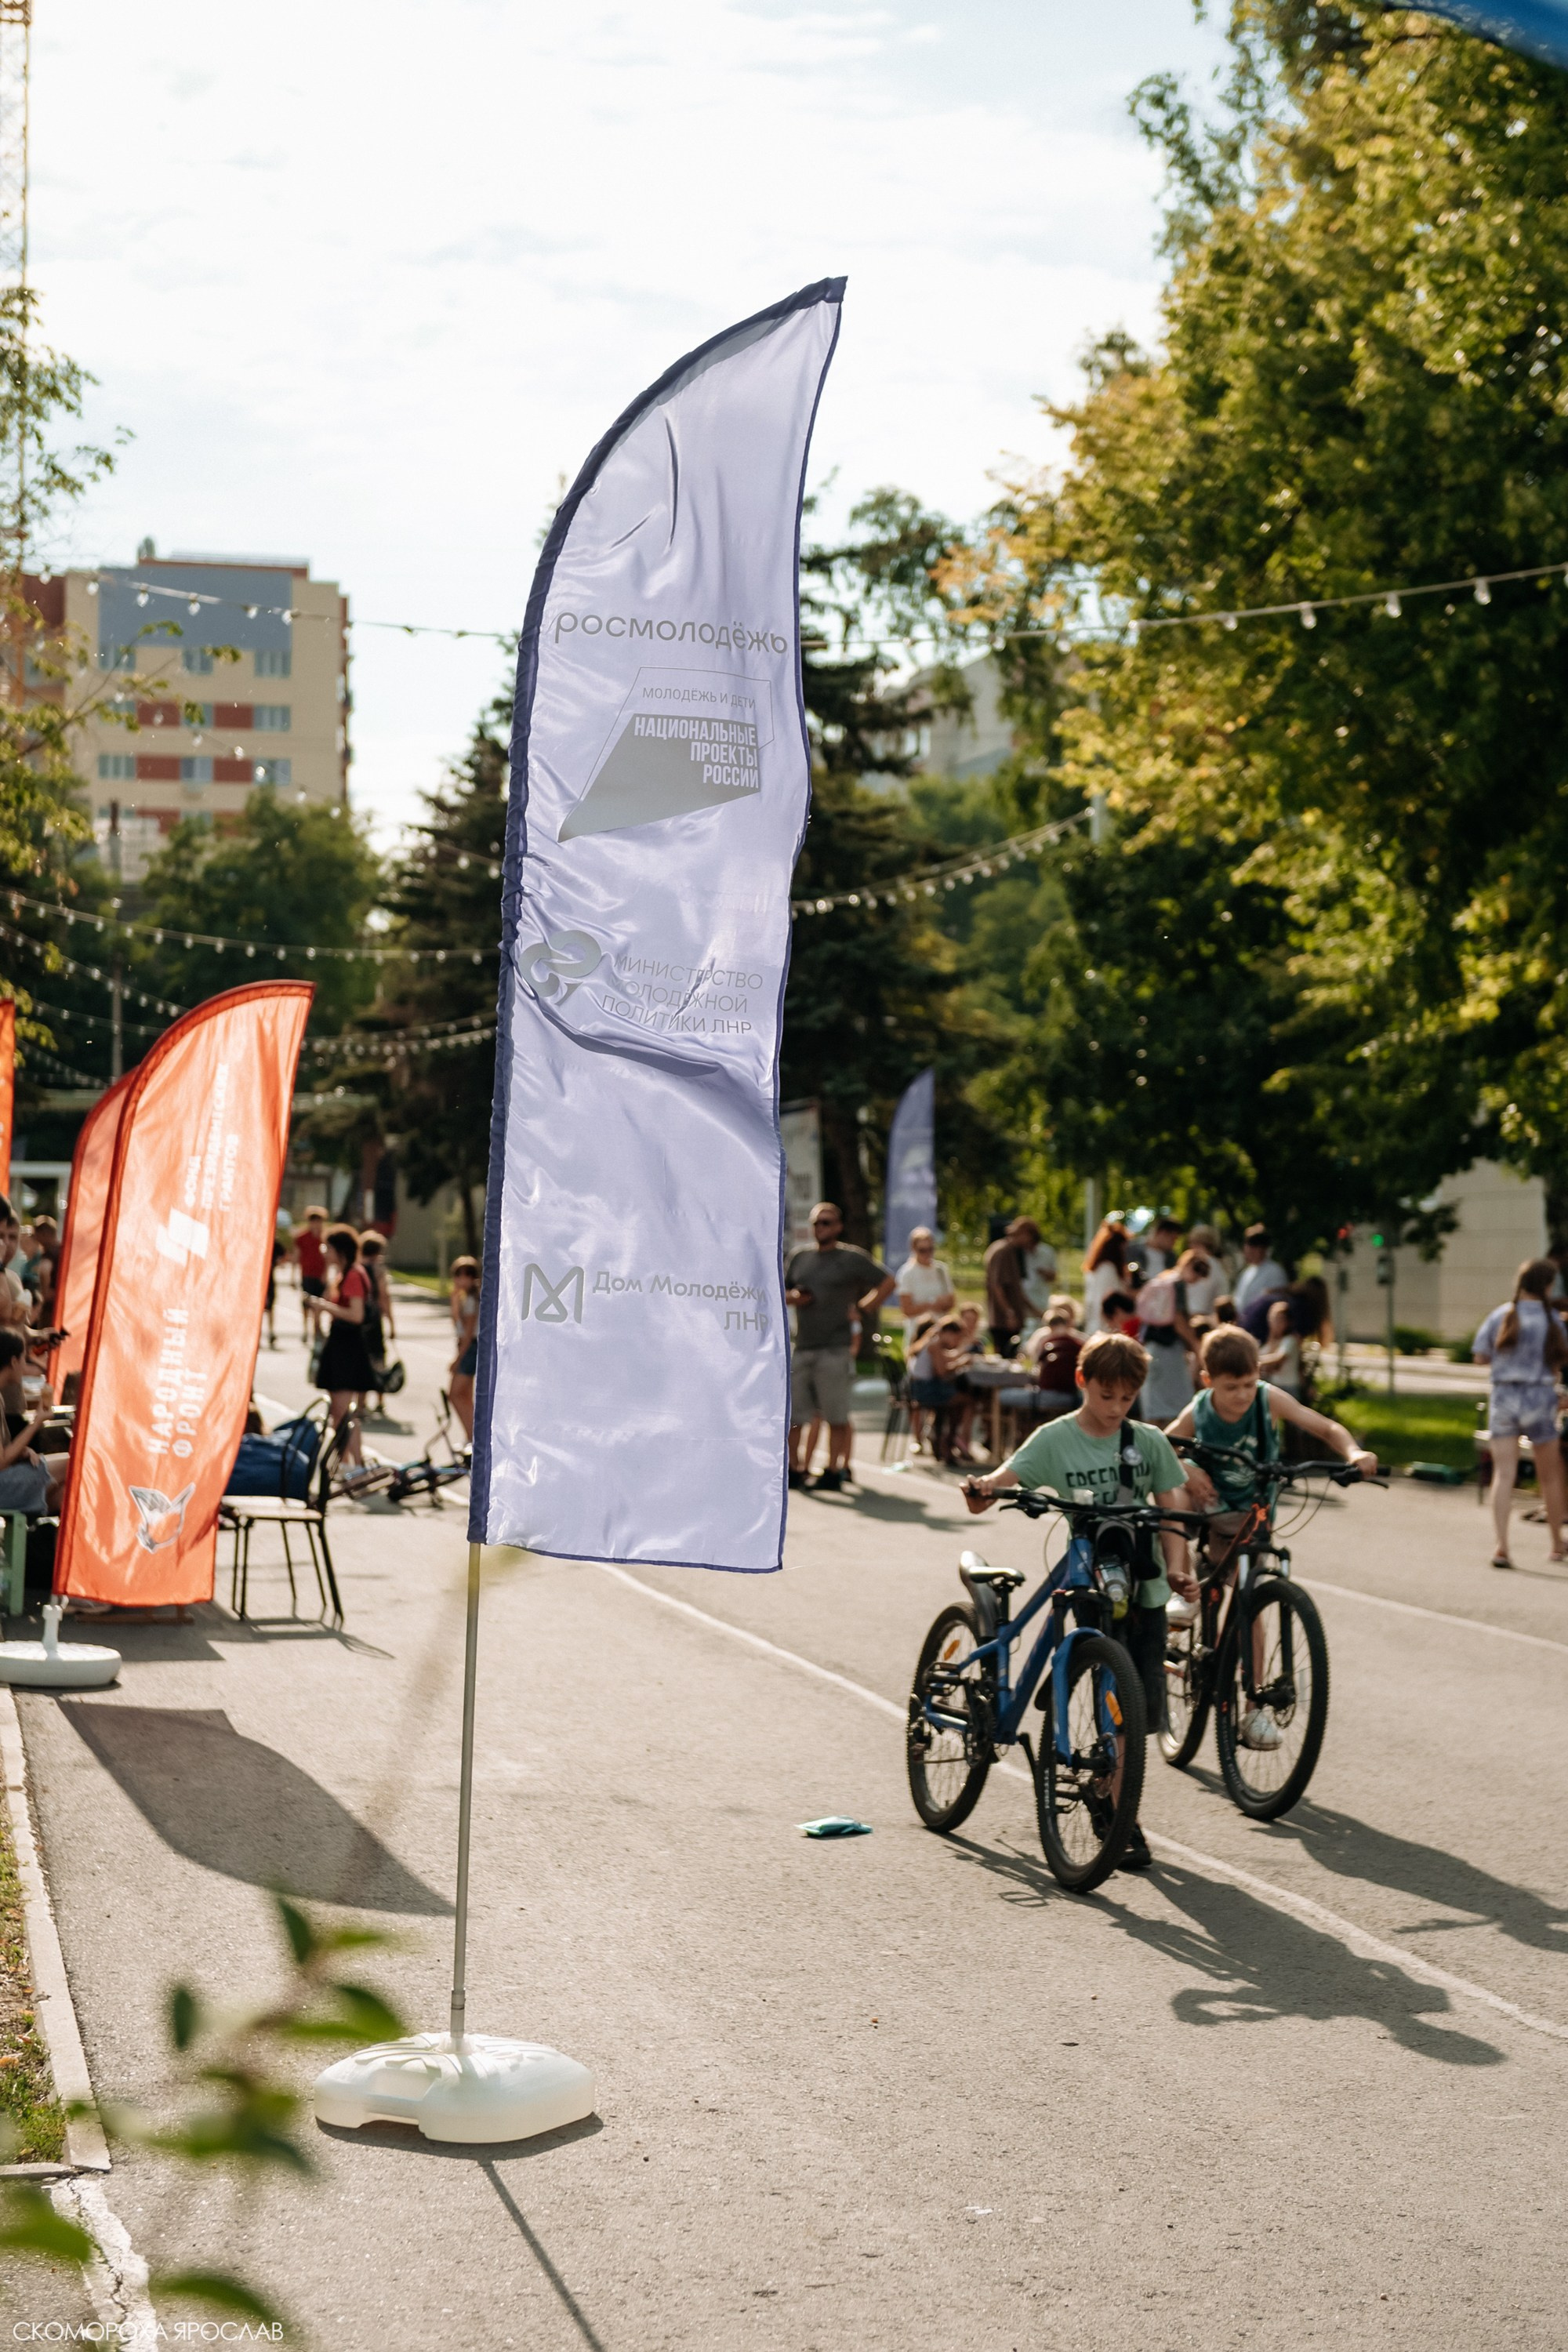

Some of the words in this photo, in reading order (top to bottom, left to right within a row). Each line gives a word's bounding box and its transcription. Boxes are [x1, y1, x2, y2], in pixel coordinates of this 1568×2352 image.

[554, 612, 788, 654] росмолодёжь
[642, 687, 717, 702] МОЛОДЁЖЬ
[720, 692, 728, 704] И
[731, 695, 756, 709] ДЕТИ
[633, 717, 757, 746] НАЦИОНАЛЬНЫЕ
[690, 742, 758, 768] ПРОЕКТЫ
[703, 764, 759, 789] РОССИИ
[602, 994, 706, 1032] ПОЛИТИКИ
[711, 1018, 752, 1034] ЛНР
[592, 1271, 642, 1294] Дом
[650, 1275, 766, 1303] Молодёжи
[724, 1311, 769, 1331] ЛНР
[147, 1308, 189, 1454] НАРОДНЫЙ
[172, 1367, 208, 1458] ФРОНТ
